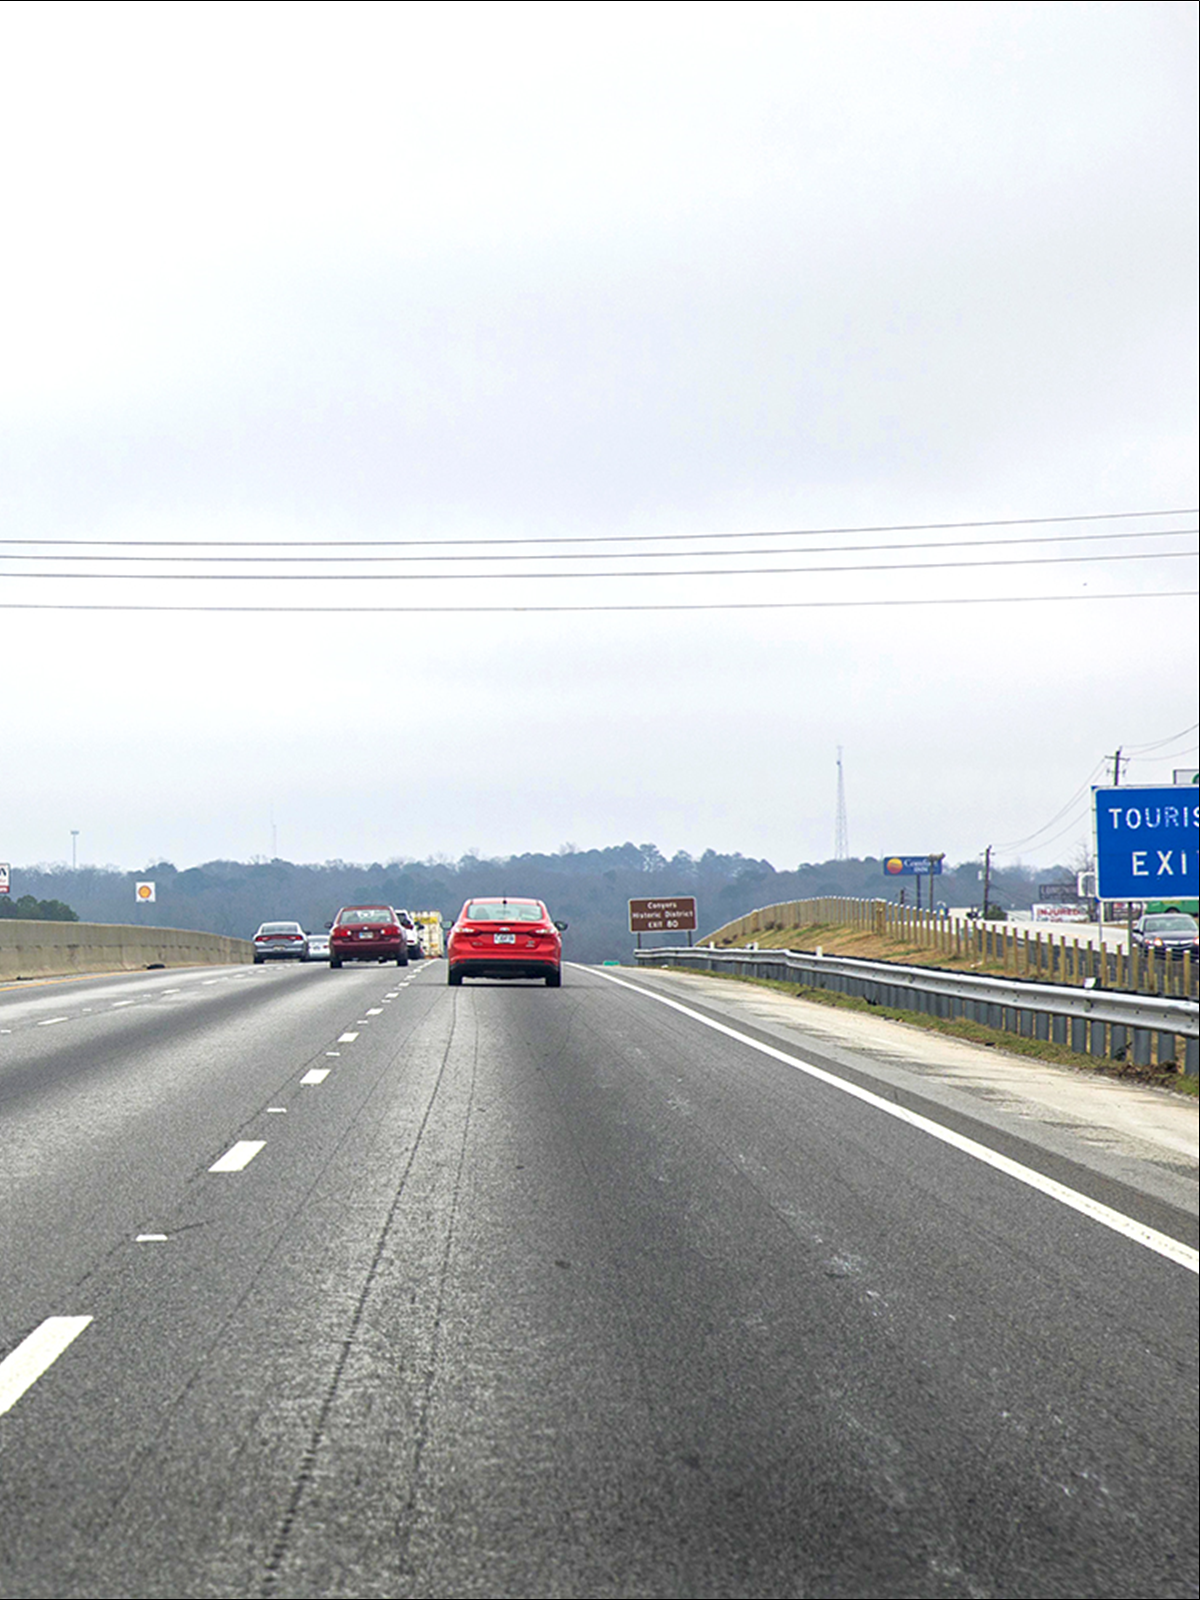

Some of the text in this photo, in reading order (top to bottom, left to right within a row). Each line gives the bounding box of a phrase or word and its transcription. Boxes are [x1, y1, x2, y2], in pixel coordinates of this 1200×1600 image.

[1132, 850, 1199, 876] EXI
[647, 902, 677, 910] Conyers
[632, 910, 694, 919] Historic District
[666, 920, 679, 928] 80
